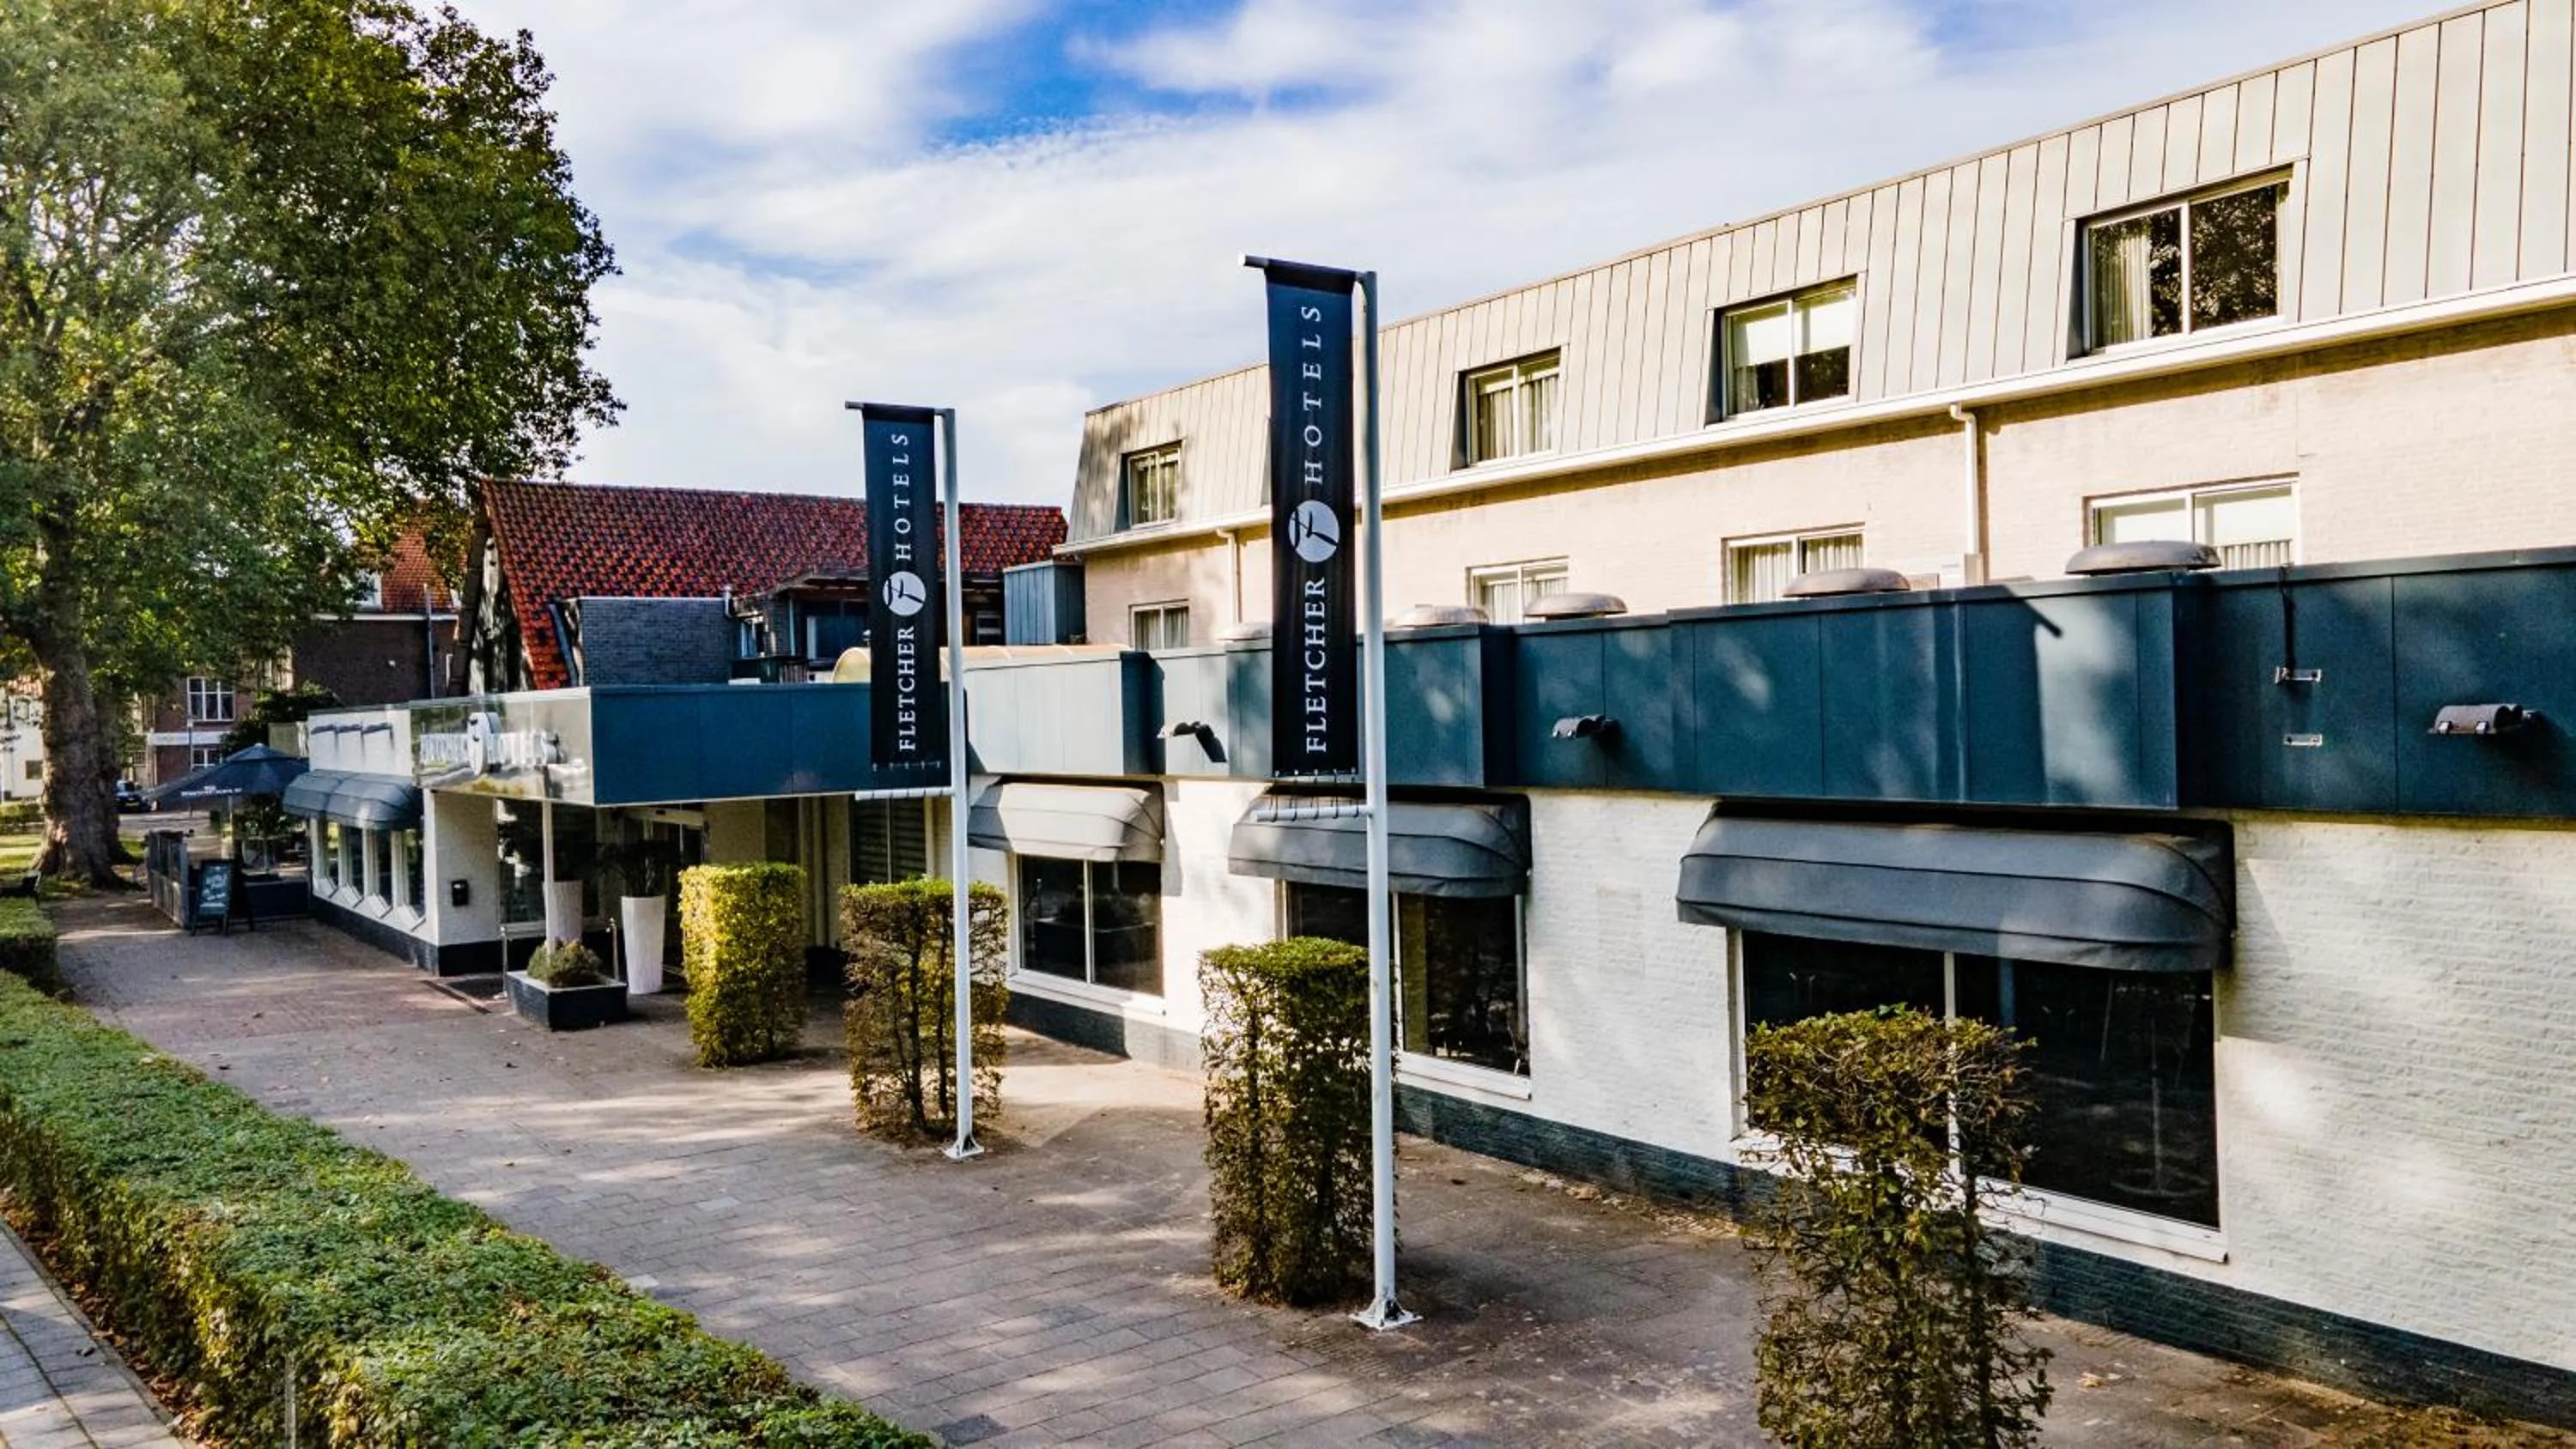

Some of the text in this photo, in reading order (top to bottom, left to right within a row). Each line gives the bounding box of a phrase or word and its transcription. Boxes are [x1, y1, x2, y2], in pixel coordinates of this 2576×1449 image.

[890, 433, 916, 750] FLETCHER HOTELS
[1301, 306, 1327, 753] FLETCHER HOTELS
